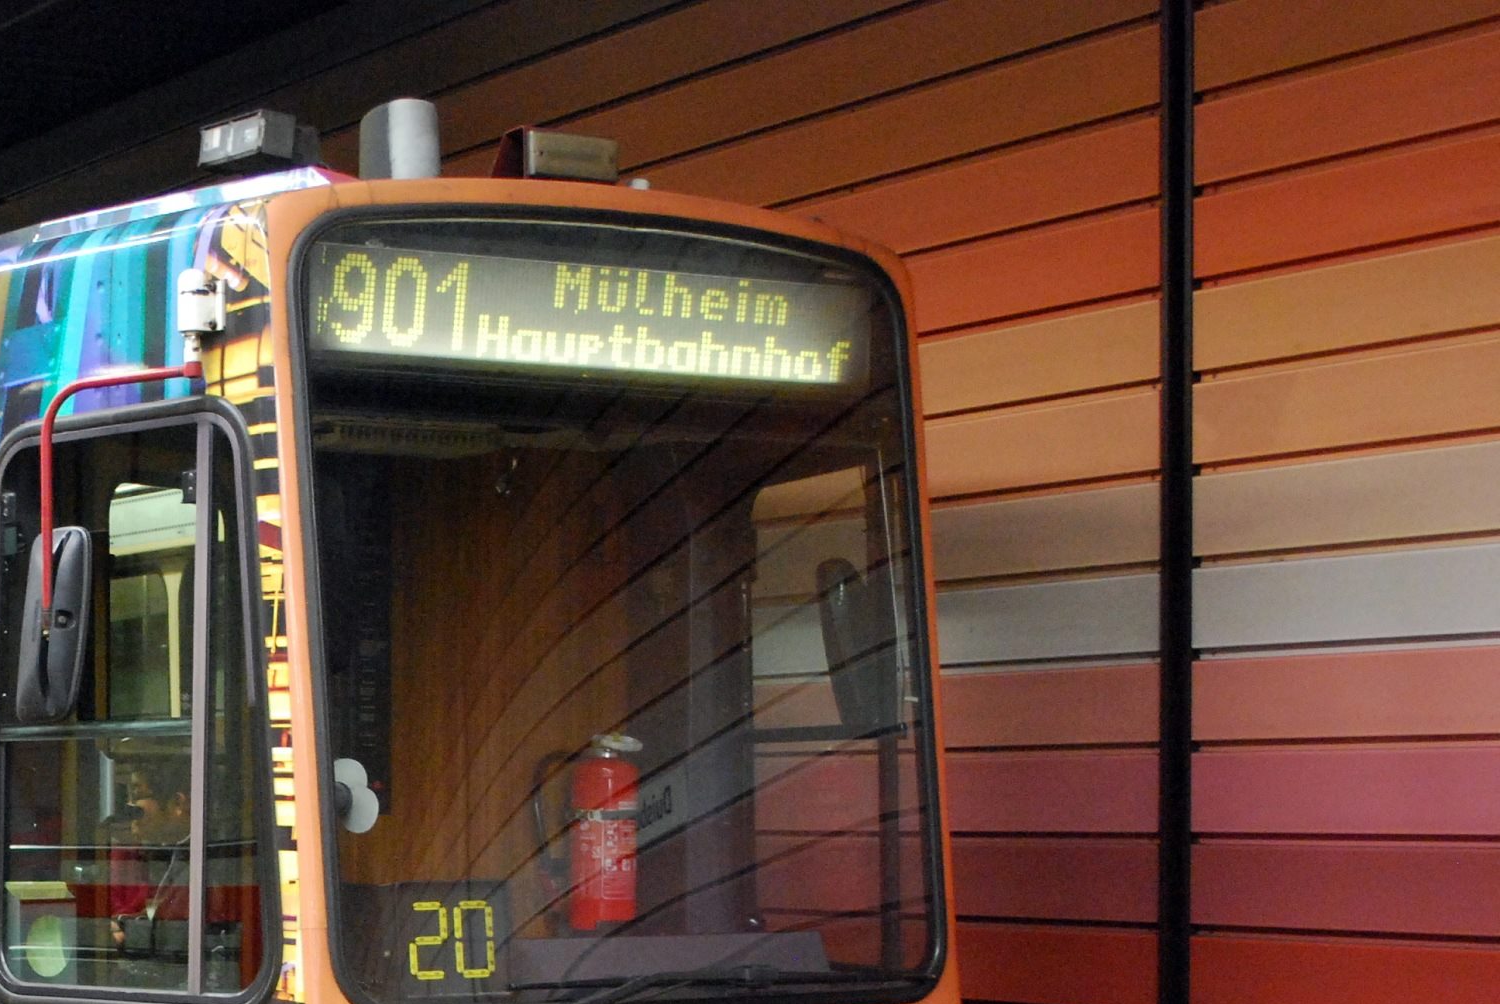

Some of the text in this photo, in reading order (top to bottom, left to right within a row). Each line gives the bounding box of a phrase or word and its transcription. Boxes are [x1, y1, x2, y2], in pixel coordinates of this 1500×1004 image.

[331, 253, 469, 351] 901
[553, 263, 789, 327] Mülheim
[475, 314, 851, 384] Hauptbahnhof
[409, 900, 495, 980] 20
